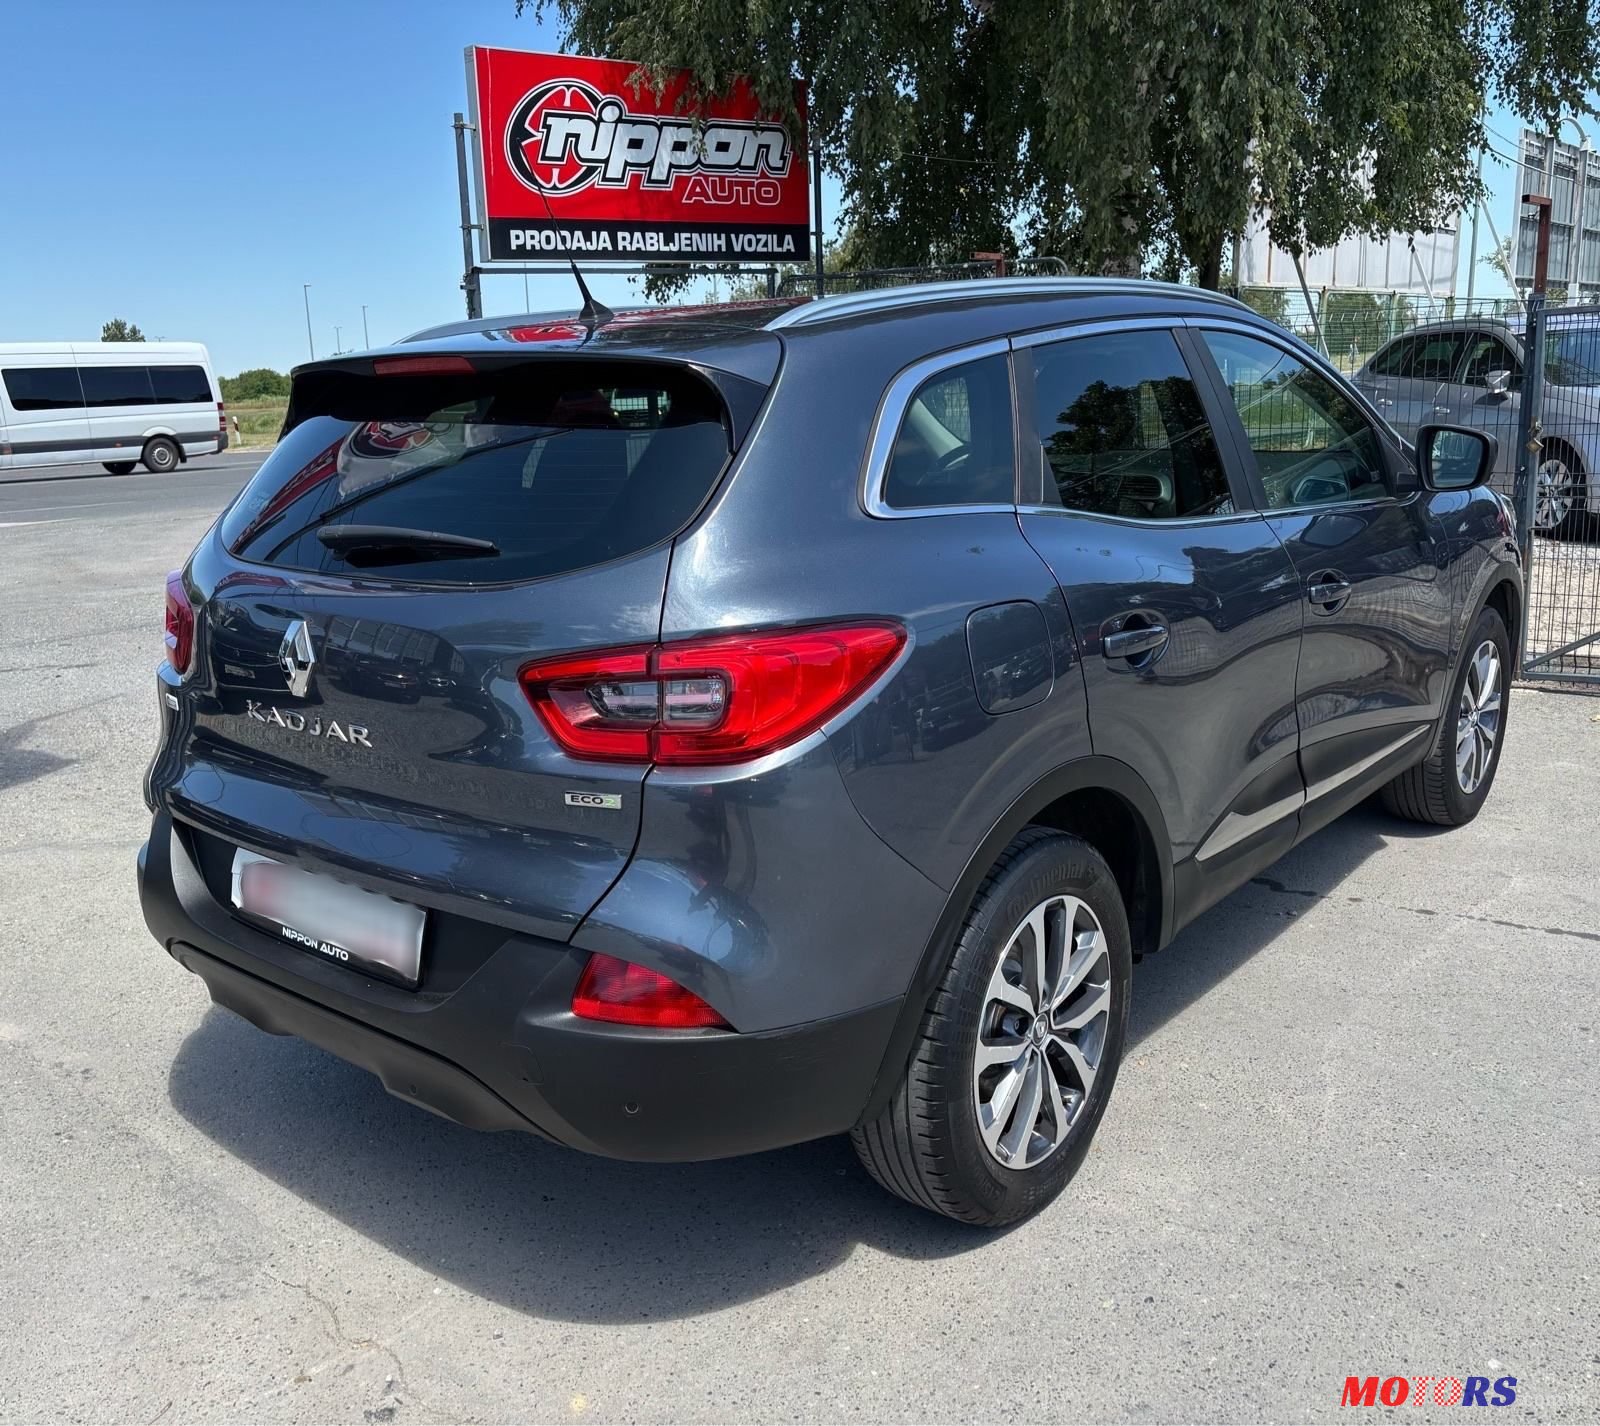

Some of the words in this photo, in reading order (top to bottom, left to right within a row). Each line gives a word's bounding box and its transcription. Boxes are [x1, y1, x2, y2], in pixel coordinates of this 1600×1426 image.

[543, 103, 788, 182] nippon
[682, 177, 781, 205] AUTO
[509, 229, 613, 251] PRODAJA
[617, 231, 727, 252] RABLJENIH
[731, 233, 796, 253] VOZILA
[246, 699, 373, 748] KADJAR
[282, 926, 318, 950] NIPPON
[319, 942, 349, 961] AUTO
